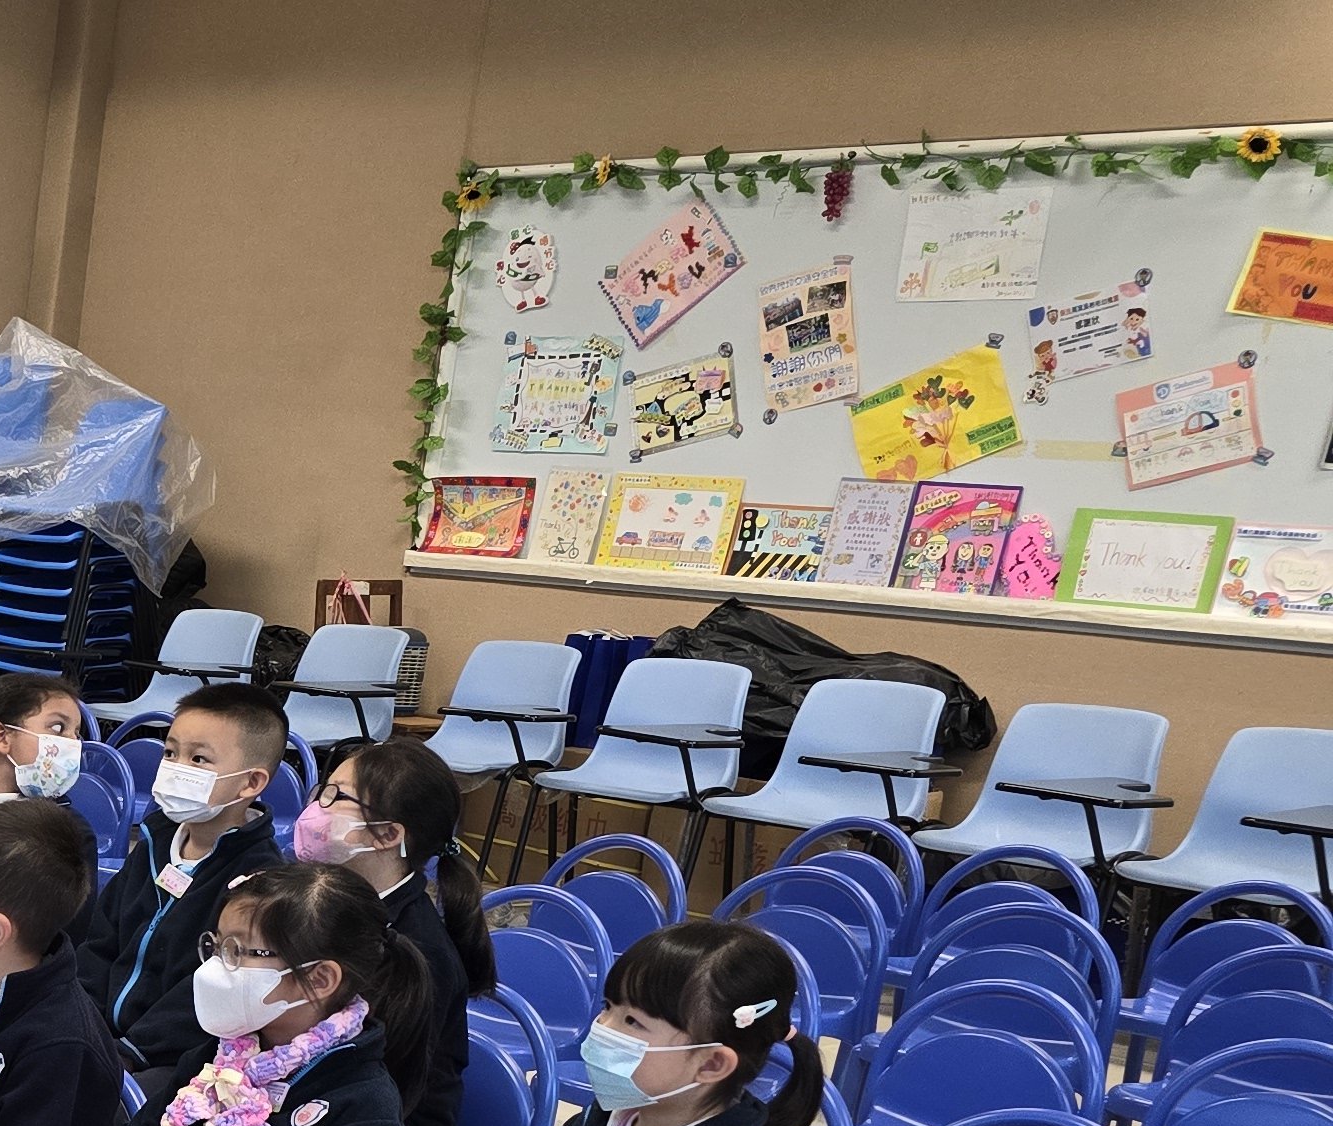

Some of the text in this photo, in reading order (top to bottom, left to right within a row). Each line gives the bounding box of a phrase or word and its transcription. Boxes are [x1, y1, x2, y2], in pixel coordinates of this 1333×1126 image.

[770, 344, 842, 378] 謝謝你們
[770, 510, 819, 532] Thank
[846, 509, 892, 528] 感謝狀
[771, 531, 803, 548] You!
[1100, 540, 1146, 567] Thank
